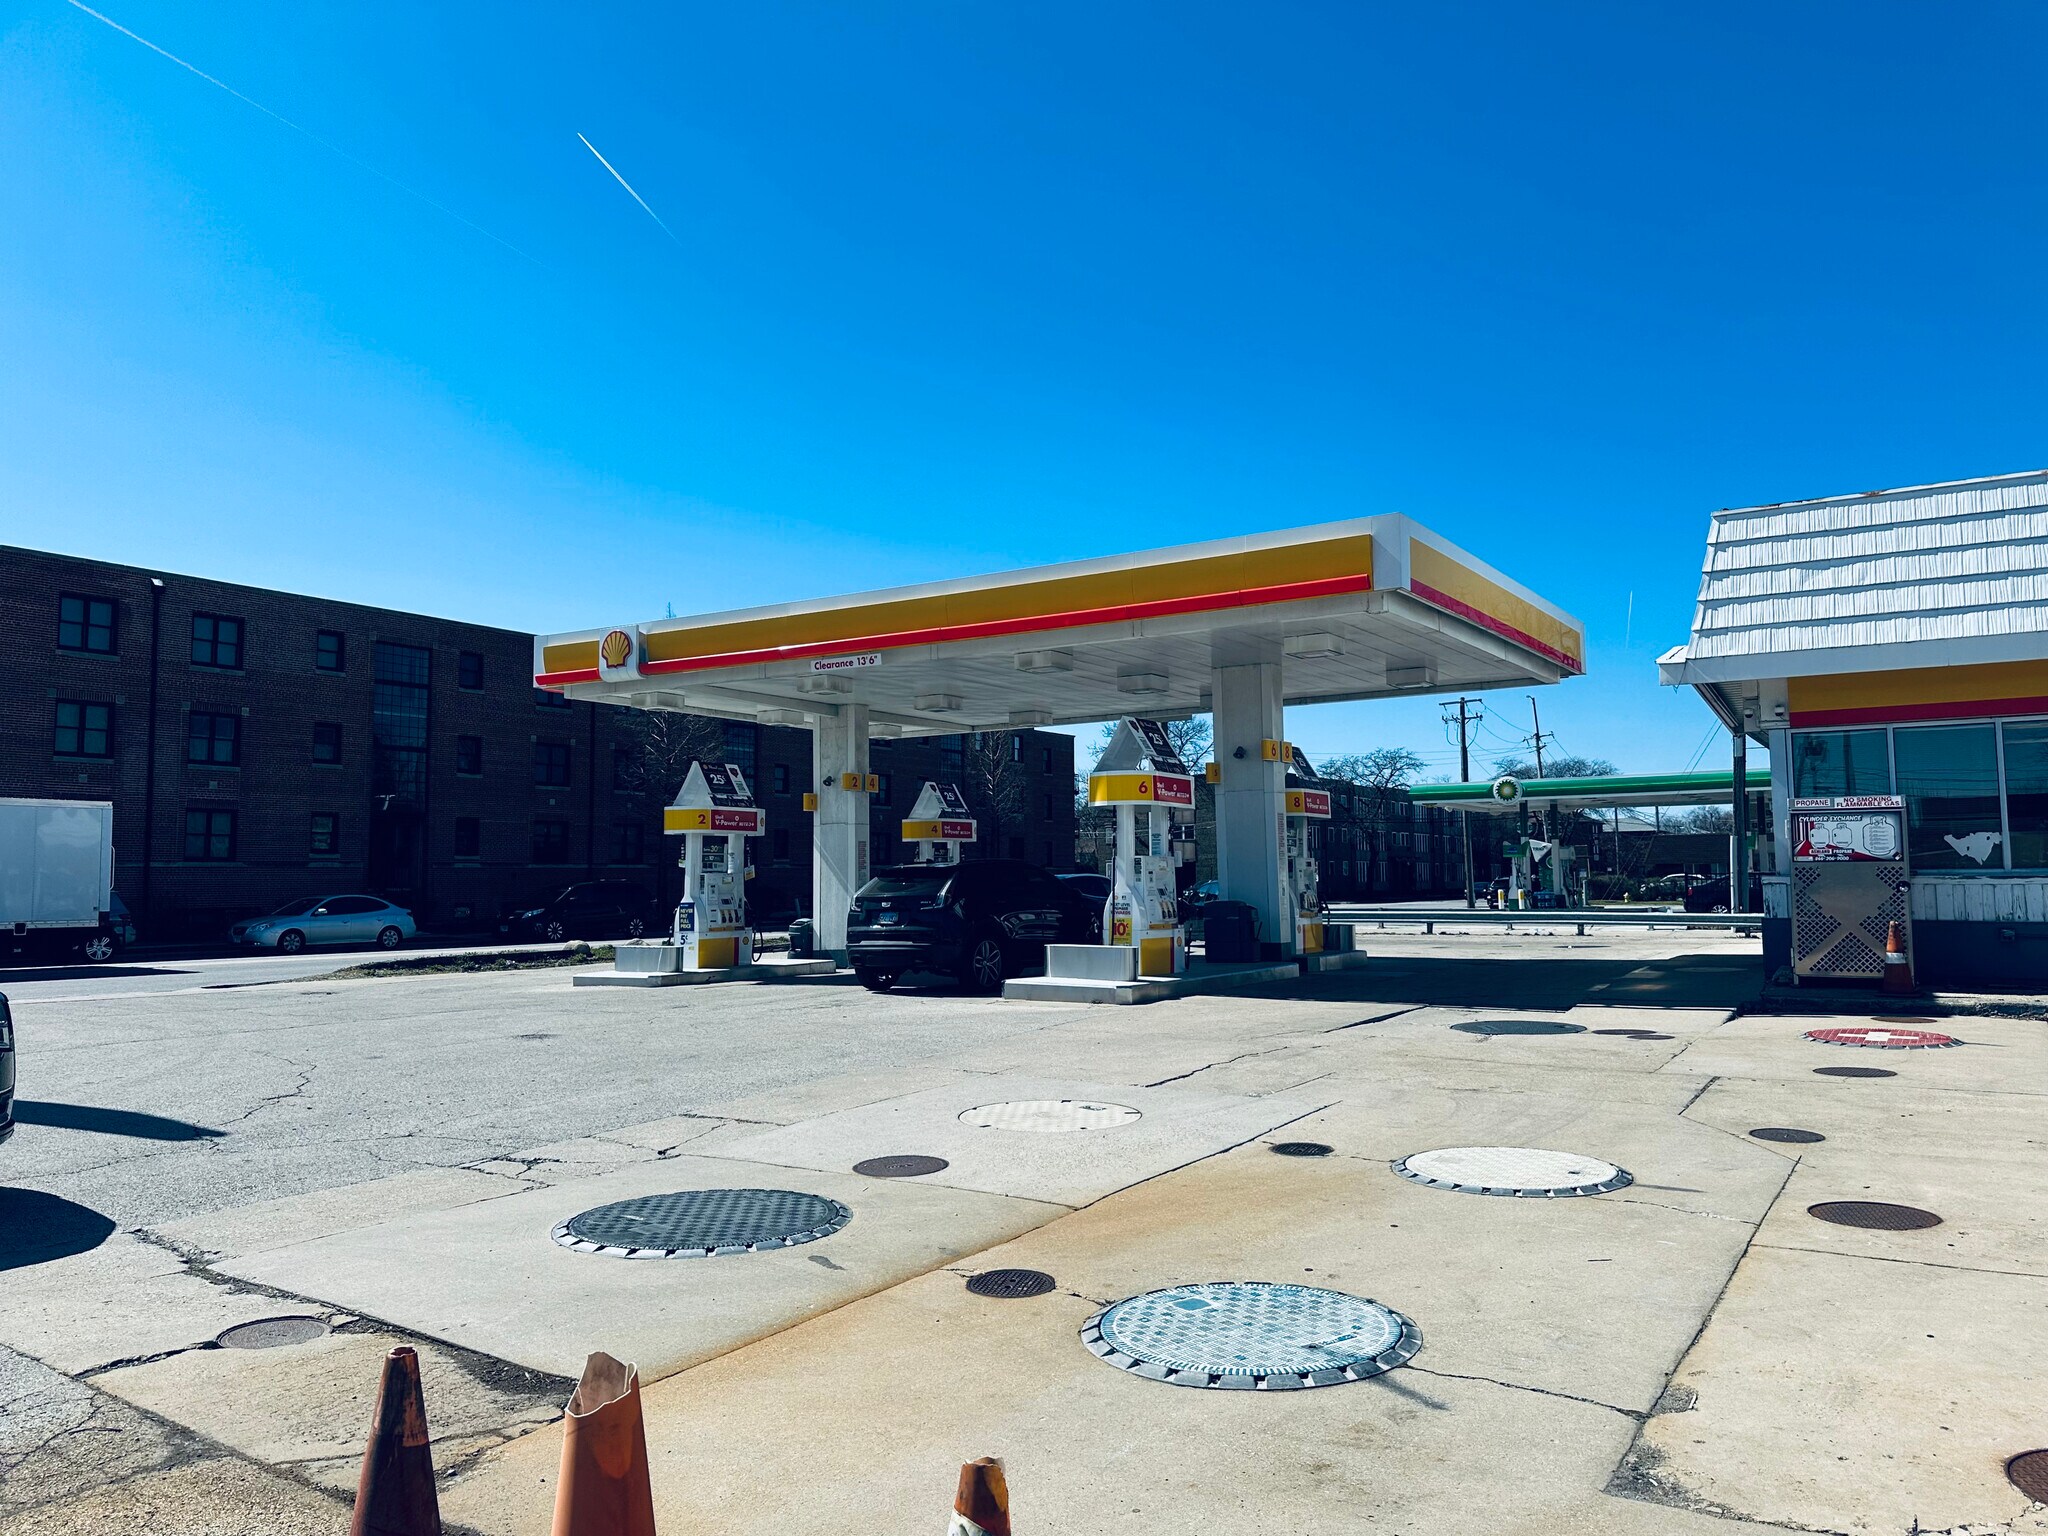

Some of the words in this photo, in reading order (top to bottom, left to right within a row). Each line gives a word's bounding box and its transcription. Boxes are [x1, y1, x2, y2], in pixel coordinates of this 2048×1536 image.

[814, 660, 854, 670] Clearance
[1271, 743, 1276, 757] 6
[1285, 745, 1290, 758] 8
[852, 776, 858, 787] 2
[869, 778, 875, 788] 4
[1138, 781, 1148, 794] 6
[1293, 796, 1301, 808] 8
[698, 814, 706, 825] 2
[715, 819, 738, 827] V-Power
[931, 825, 938, 834] 4
